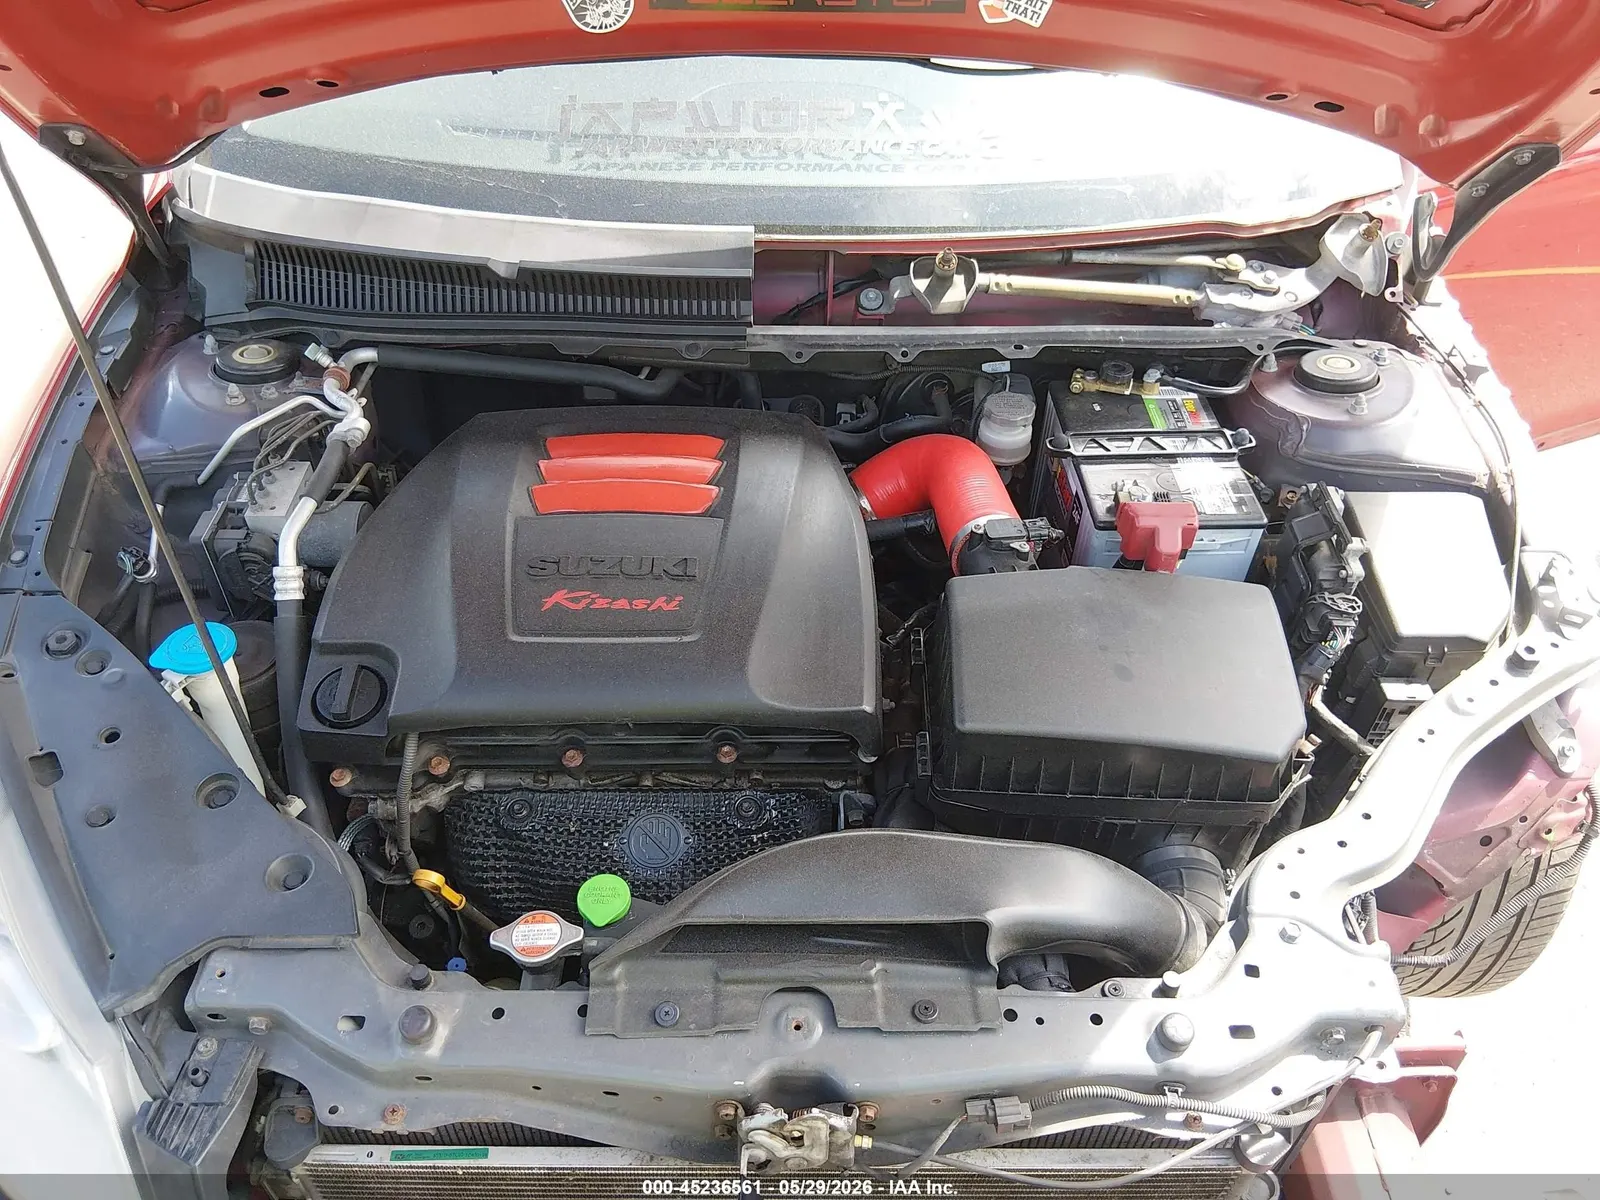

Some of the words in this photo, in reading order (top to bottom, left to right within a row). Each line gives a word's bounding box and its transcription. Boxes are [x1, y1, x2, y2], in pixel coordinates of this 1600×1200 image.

[1005, 0, 1042, 23] THAT!
[570, 161, 705, 172] JAPANESE
[711, 161, 906, 174] PERFORMANCE
[525, 555, 699, 580] SUZUKI
[540, 588, 684, 612] Kizashi
